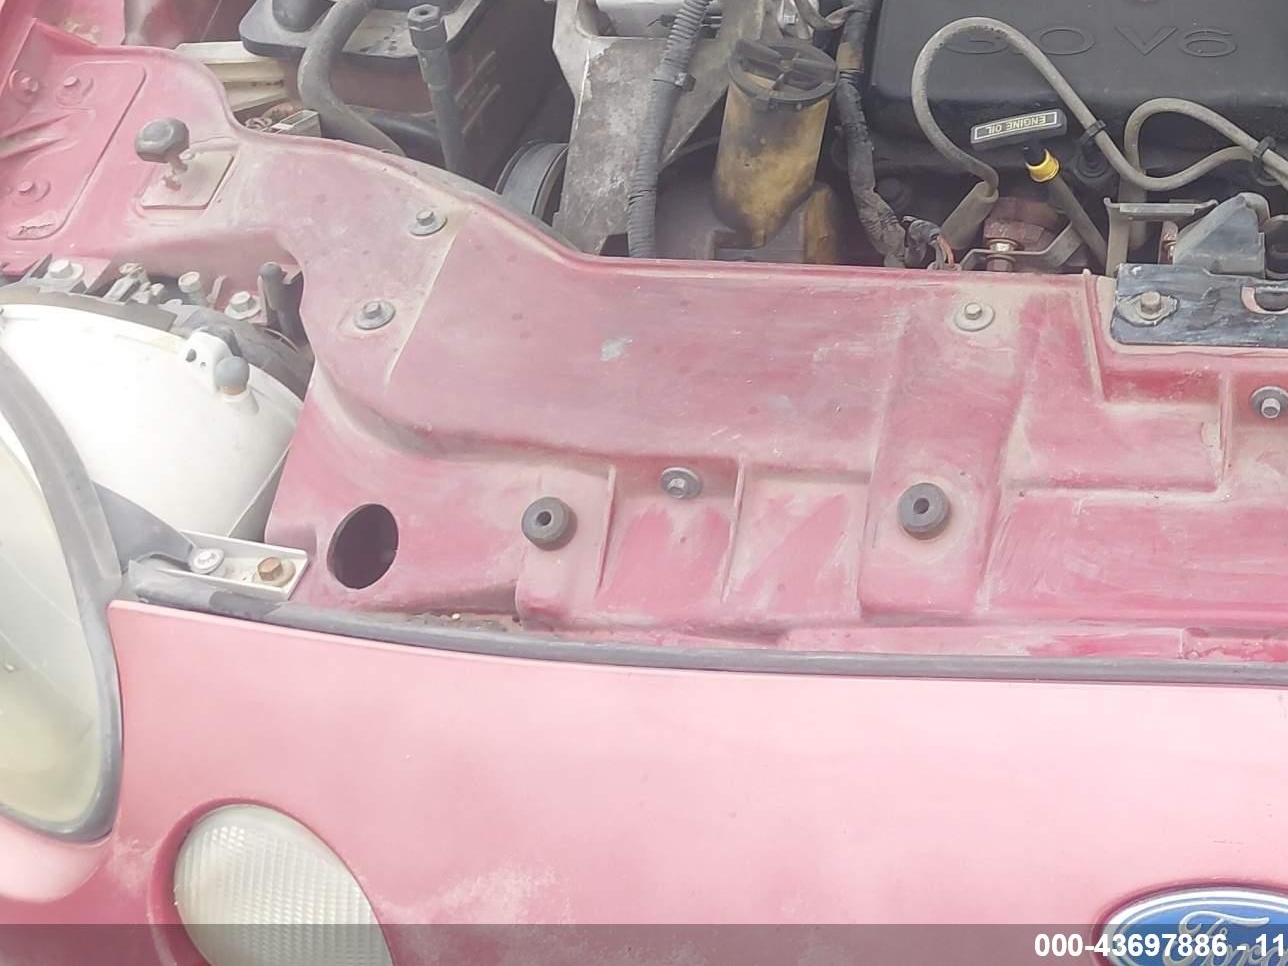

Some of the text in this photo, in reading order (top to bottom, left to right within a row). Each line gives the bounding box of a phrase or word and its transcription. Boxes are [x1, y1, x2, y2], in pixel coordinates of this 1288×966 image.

[1113, 25, 1239, 57] V6
[985, 115, 1046, 134] ENGINE OIL
